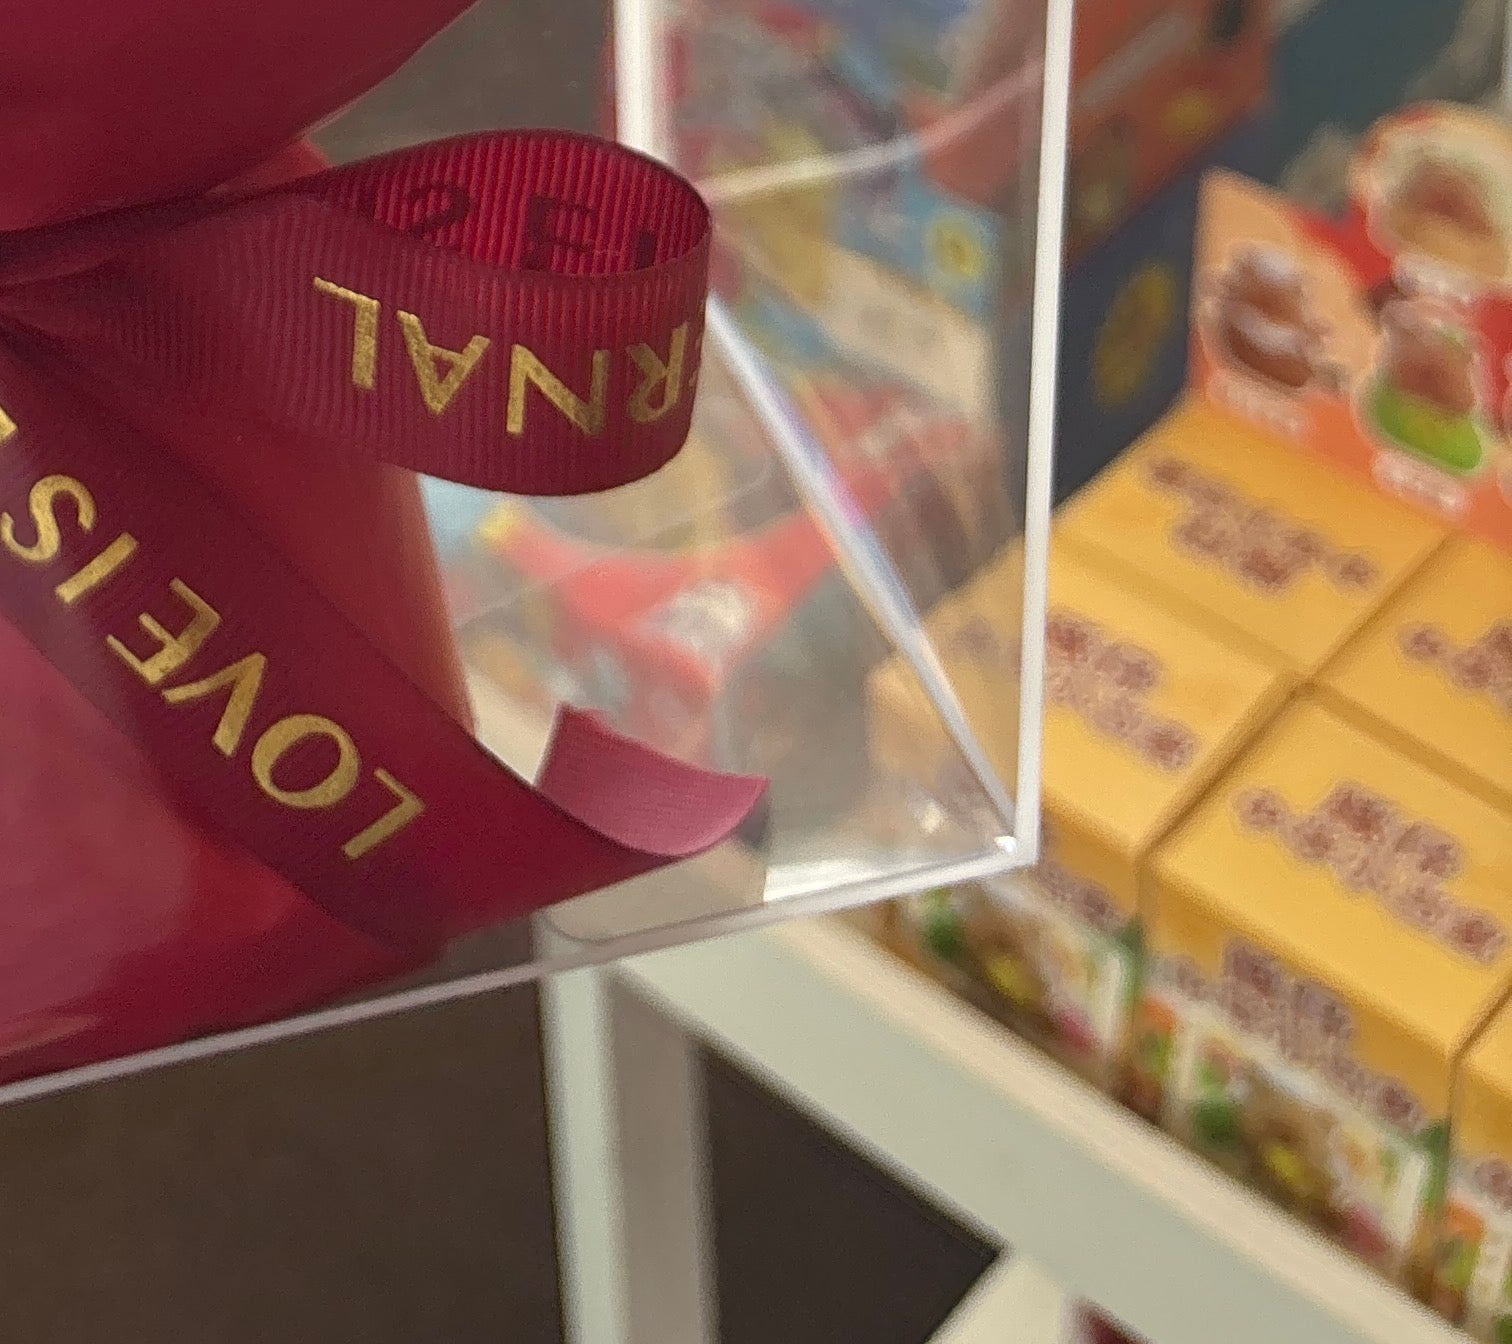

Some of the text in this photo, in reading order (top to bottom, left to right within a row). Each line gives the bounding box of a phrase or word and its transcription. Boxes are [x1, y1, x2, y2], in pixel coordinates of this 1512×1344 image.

[313, 275, 694, 436] RNAL
[0, 473, 139, 606] IS
[107, 577, 426, 862] LOVE
